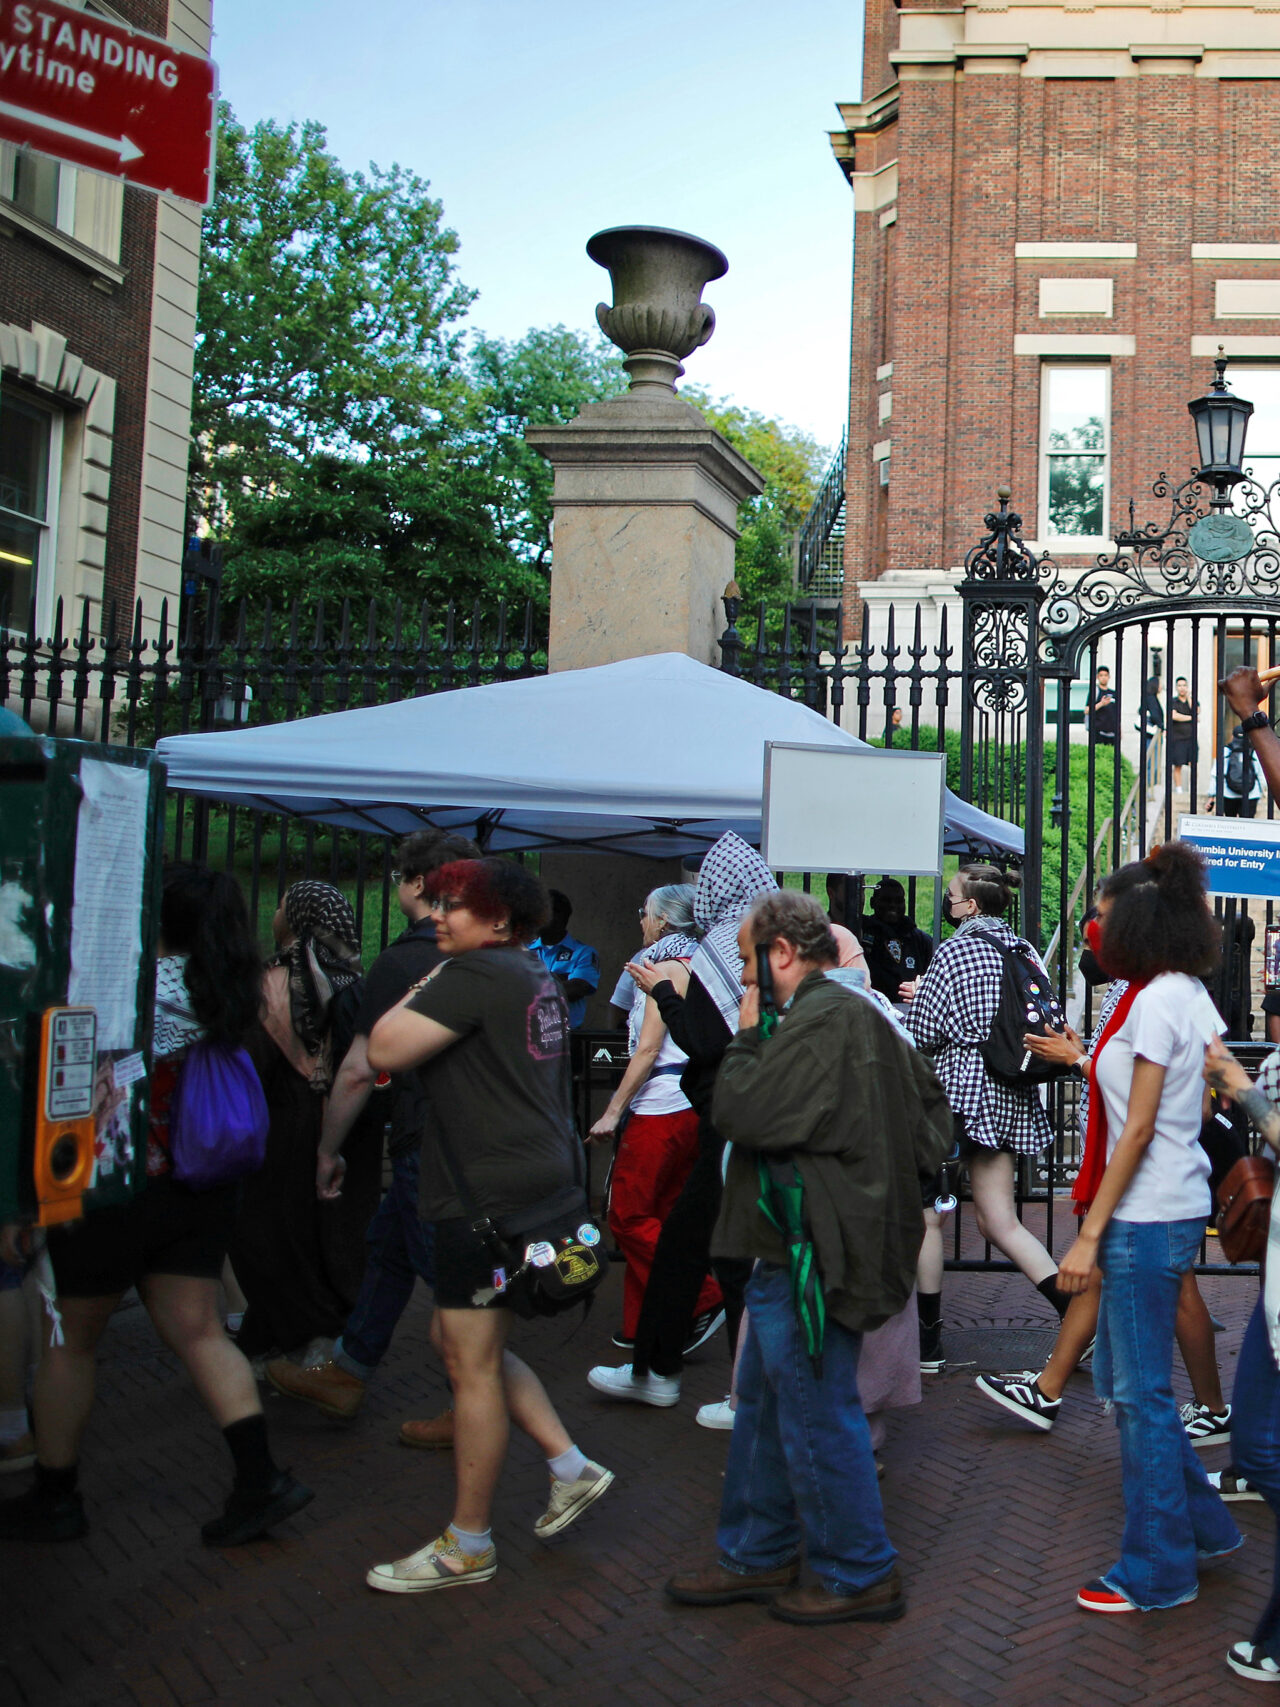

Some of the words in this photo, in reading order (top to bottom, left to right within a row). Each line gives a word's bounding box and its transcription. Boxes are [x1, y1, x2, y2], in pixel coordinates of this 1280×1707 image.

[14, 5, 179, 87] STANDING
[1228, 847, 1273, 859] University
[1225, 859, 1239, 868] for
[1240, 860, 1265, 870] Entry
